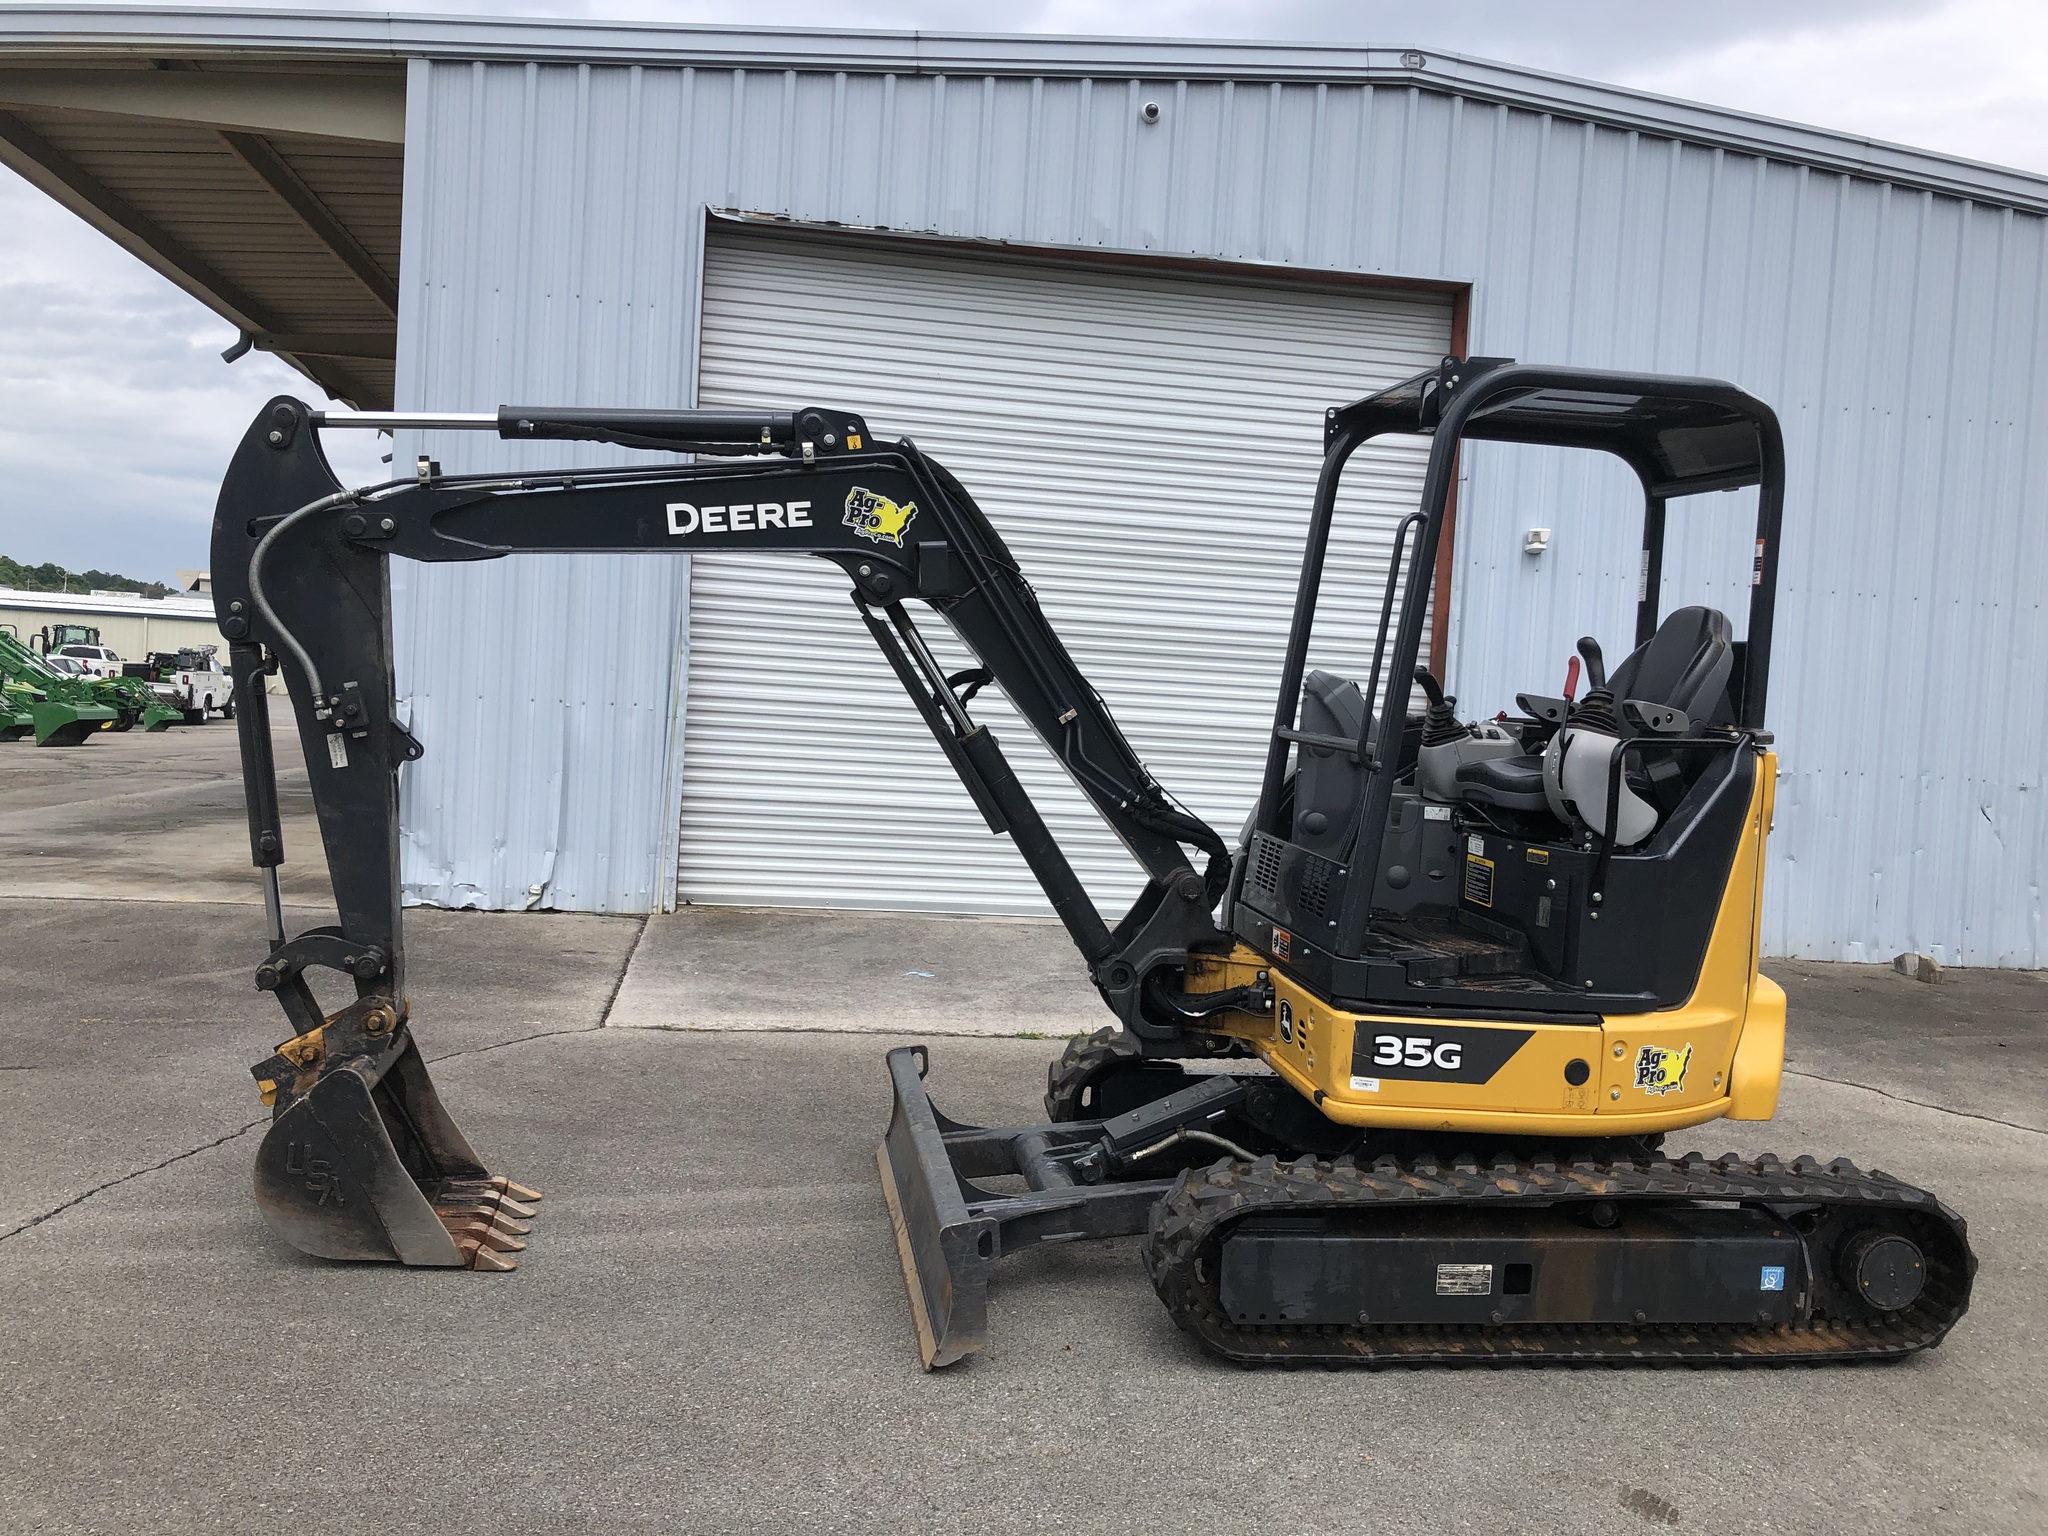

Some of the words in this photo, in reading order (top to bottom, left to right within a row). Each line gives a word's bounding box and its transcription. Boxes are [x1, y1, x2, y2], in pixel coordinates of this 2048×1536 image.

[849, 490, 884, 512] Ag-
[666, 501, 813, 534] DEERE
[846, 507, 880, 527] Pro
[1373, 1035, 1461, 1069] 35G
[1638, 1049, 1667, 1069] Ag-
[1637, 1067, 1665, 1084] Pro
